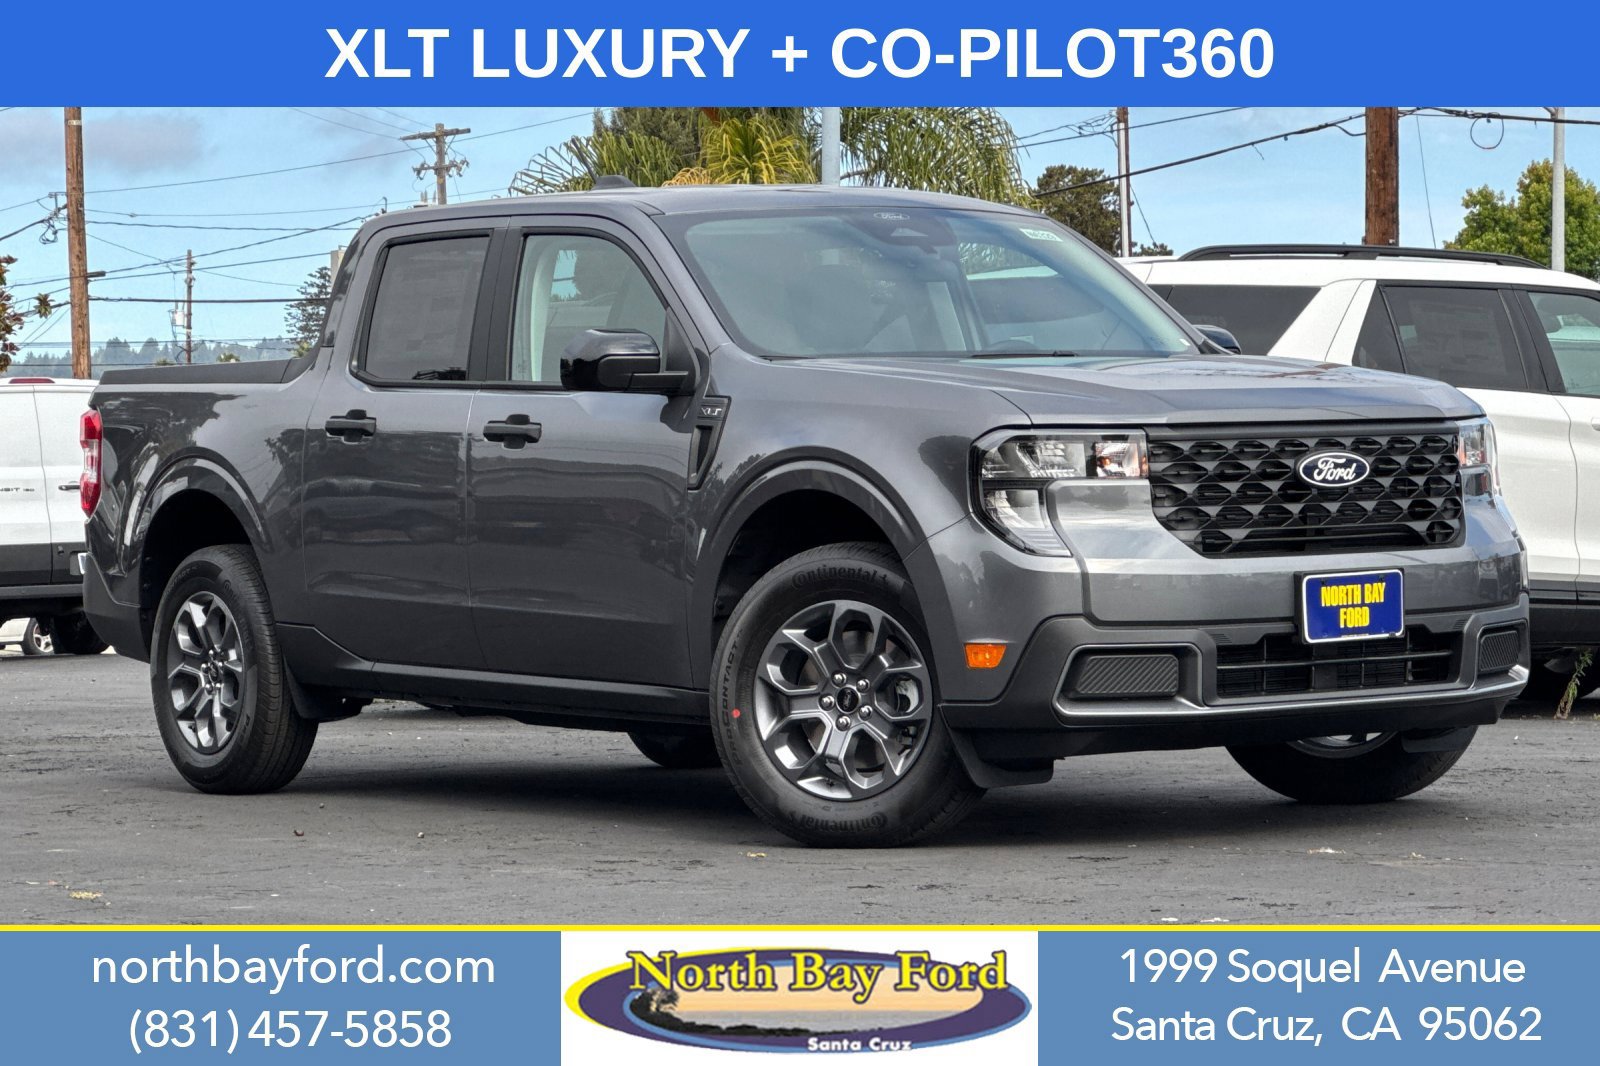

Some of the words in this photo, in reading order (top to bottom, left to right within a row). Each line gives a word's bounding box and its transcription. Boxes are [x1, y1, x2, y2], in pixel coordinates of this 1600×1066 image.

[1313, 457, 1357, 482] Ford
[1320, 584, 1361, 607] NORTH
[1364, 582, 1386, 604] BAY
[1339, 606, 1370, 628] FORD
